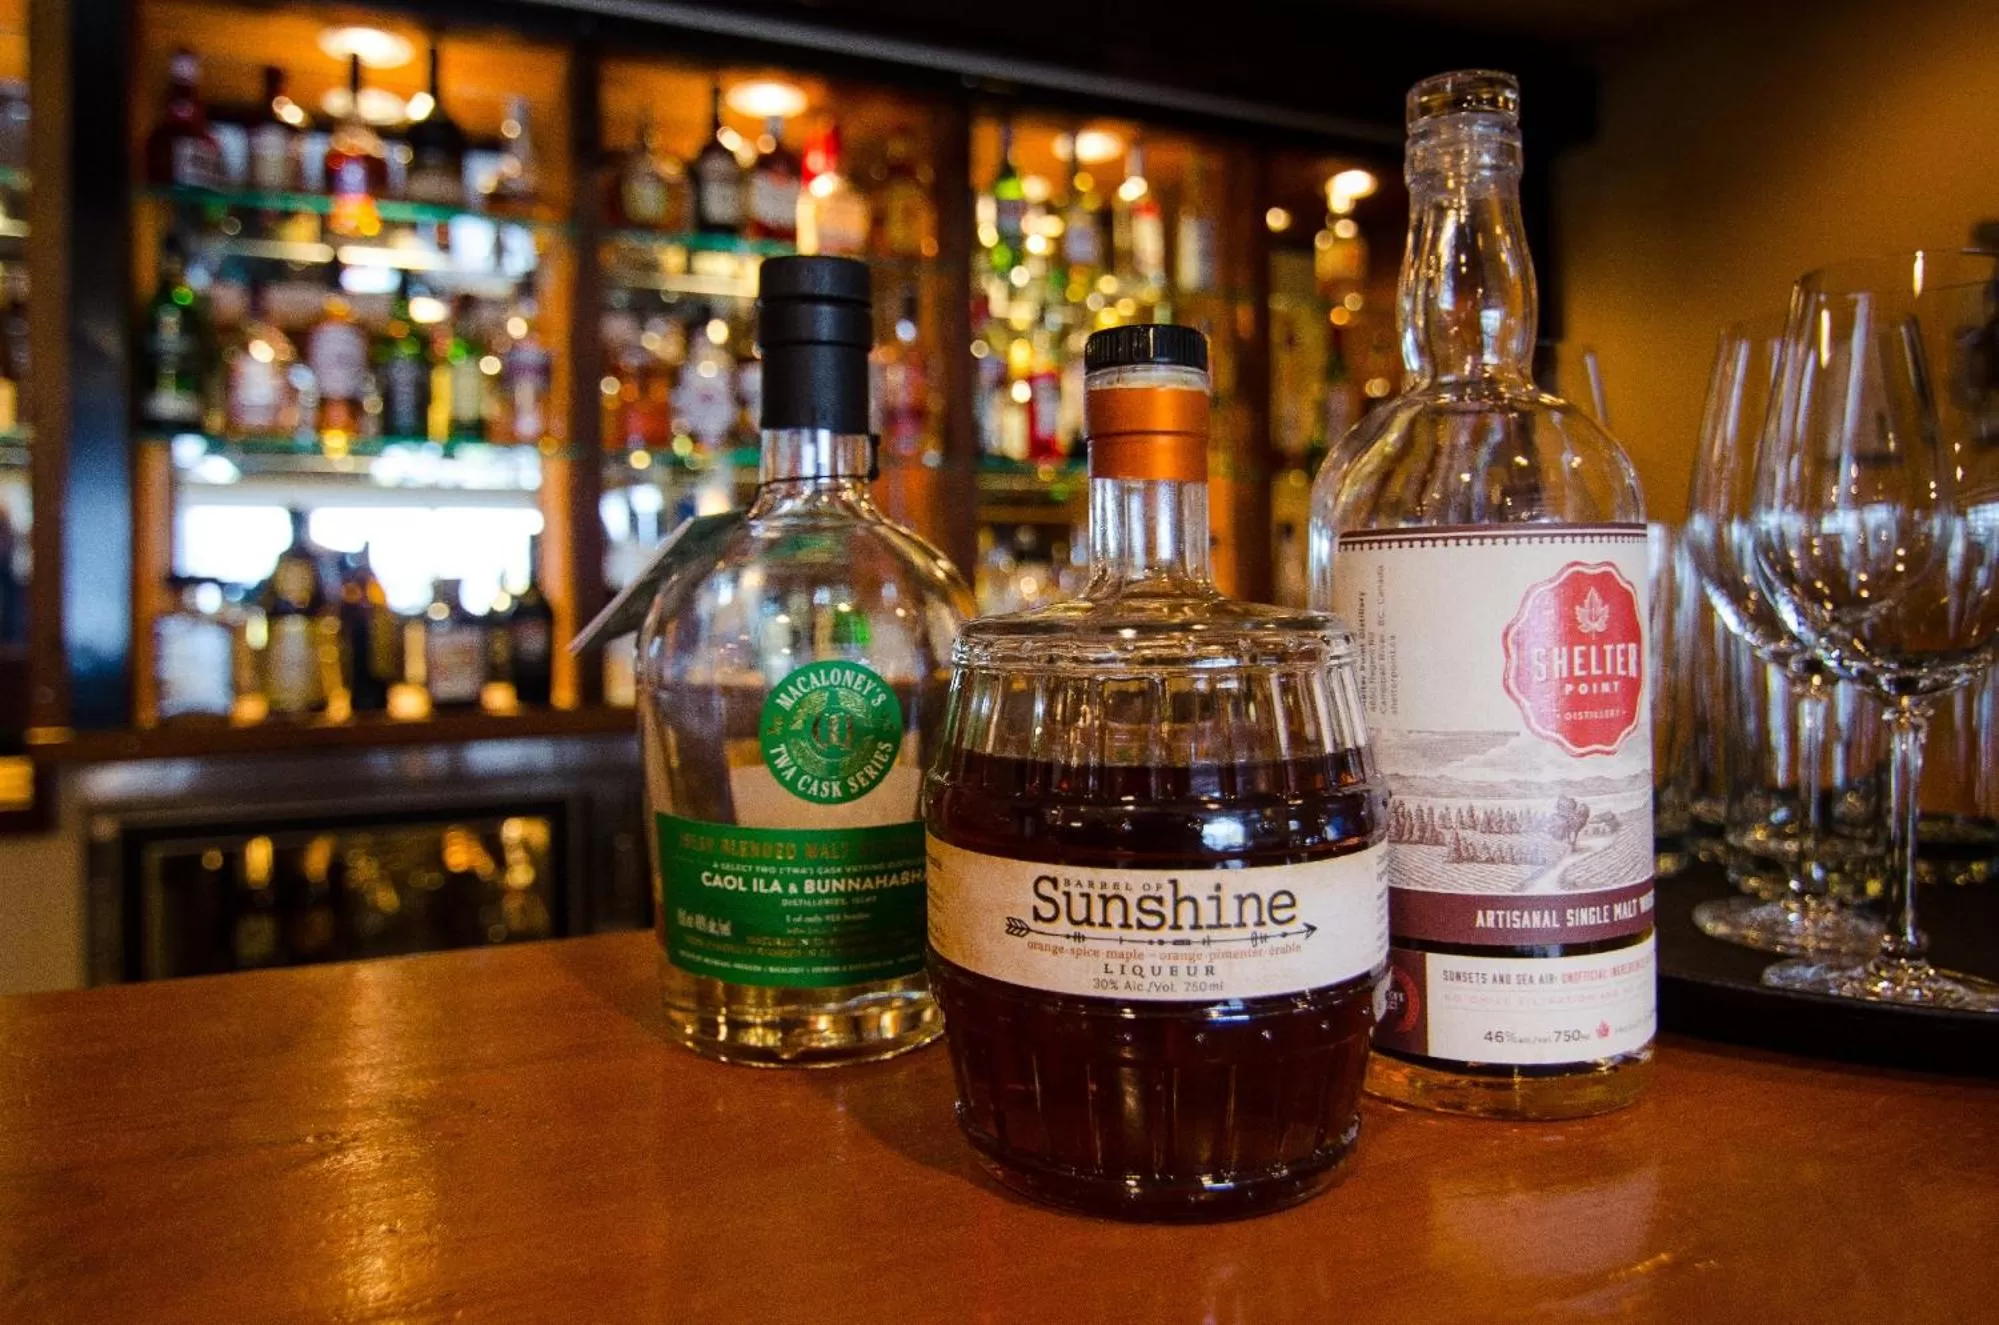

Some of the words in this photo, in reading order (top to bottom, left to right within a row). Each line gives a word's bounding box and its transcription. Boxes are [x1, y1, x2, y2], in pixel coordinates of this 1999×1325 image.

[1532, 642, 1638, 682] SHELTER
[775, 668, 887, 711] MACALONEY'S
[1564, 681, 1620, 696] POINT
[1563, 708, 1622, 721] DISTILLERY
[769, 743, 798, 781] TWA
[797, 774, 843, 798] CASK
[847, 741, 894, 793] SERIES
[720, 838, 797, 860] BLENDED
[720, 862, 752, 873] SELECT
[701, 871, 748, 892] CAOL
[752, 877, 783, 894] ILA
[788, 882, 799, 895] &
[804, 868, 926, 895] BUNNAHABH
[1063, 878, 1133, 891] BARREL
[1142, 882, 1163, 892] OF
[1032, 875, 1297, 931] Sunshine
[1475, 909, 1561, 929] ARTISANAL
[1566, 904, 1612, 928] SINGLE
[1613, 897, 1638, 922] MALT
[1103, 963, 1216, 979] LIQUEUR
[1442, 969, 1489, 985] SUNSETS
[1492, 973, 1512, 985] AND
[1516, 973, 1535, 985] SEA
[1093, 978, 1119, 991] 30%
